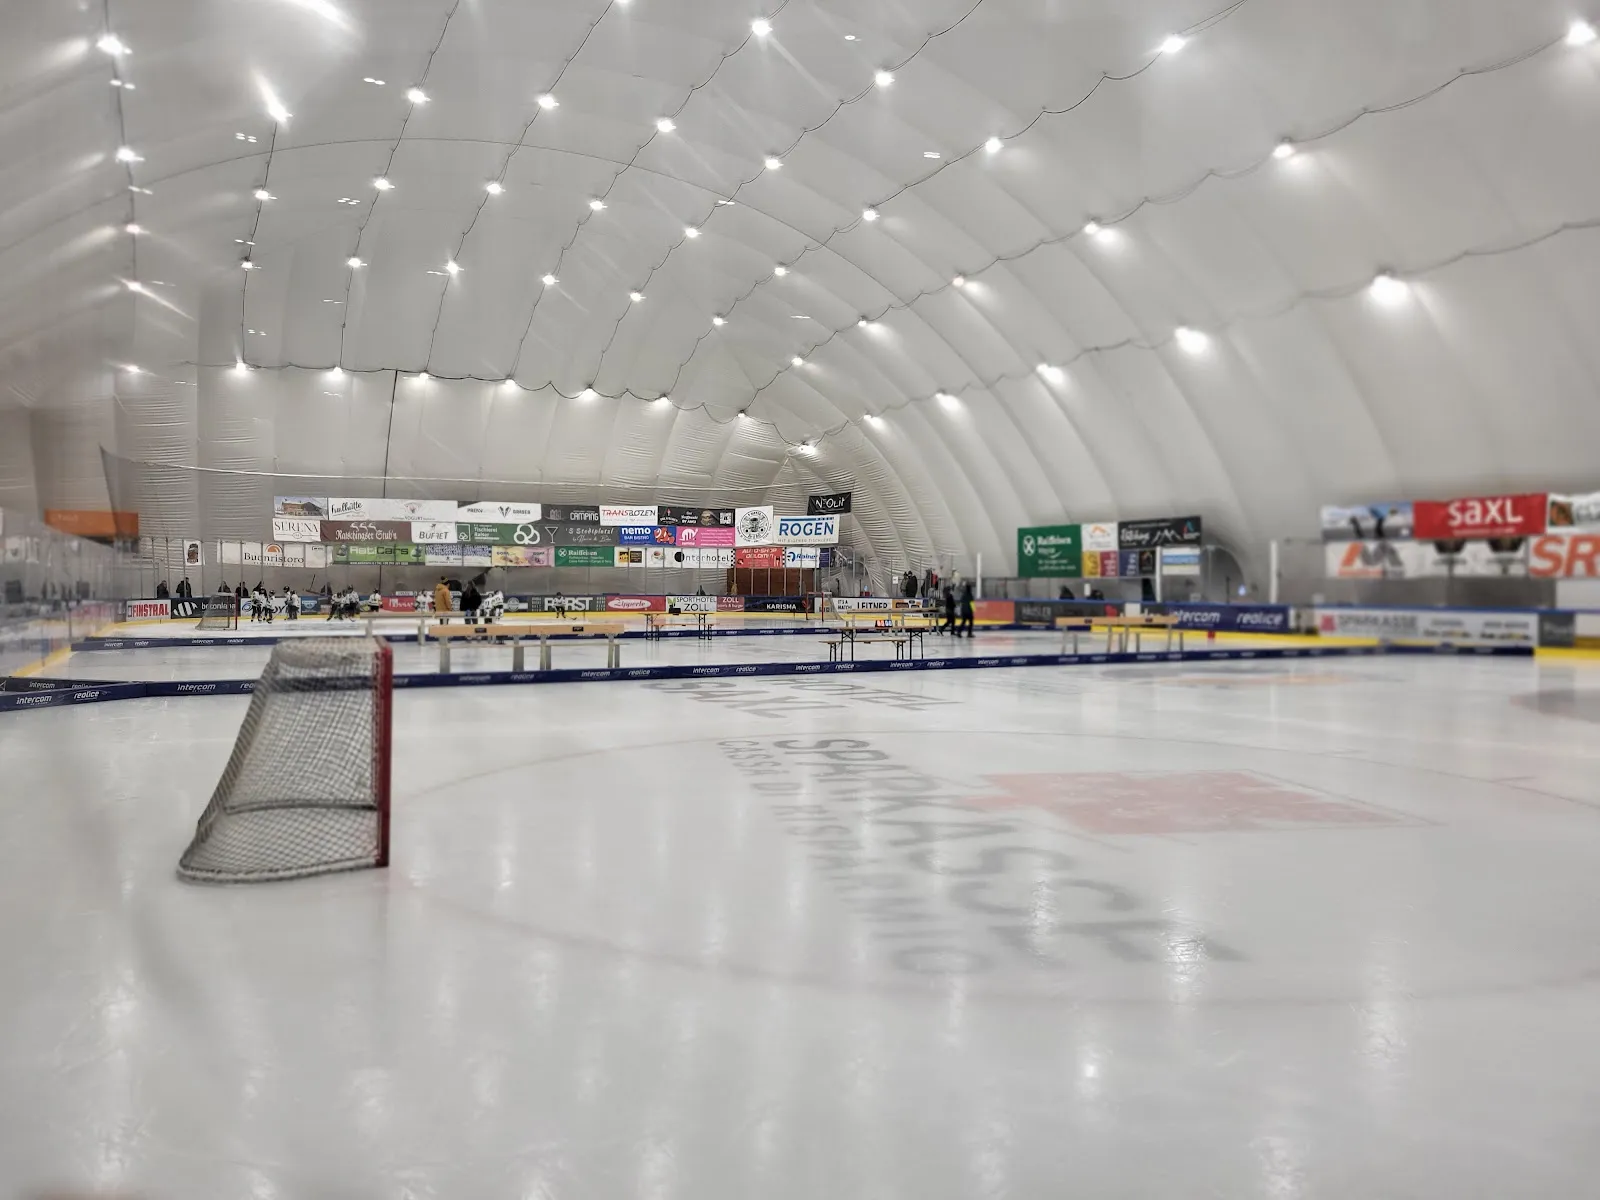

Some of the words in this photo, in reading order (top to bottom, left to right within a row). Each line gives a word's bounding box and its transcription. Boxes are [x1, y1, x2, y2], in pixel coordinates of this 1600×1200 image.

[602, 509, 656, 517] TRANSBOZEN
[274, 523, 319, 533] SERENA
[621, 527, 651, 535] nemo
[779, 522, 834, 536] ROGEN
[544, 597, 594, 611] FRST
[683, 603, 709, 612] ZOLL
[132, 603, 169, 617] FINSTRAL
[795, 663, 821, 671] intercom
[890, 661, 914, 669] intercom
[29, 681, 56, 689] intercom
[177, 682, 216, 691] intercom
[16, 694, 52, 705] intercom
